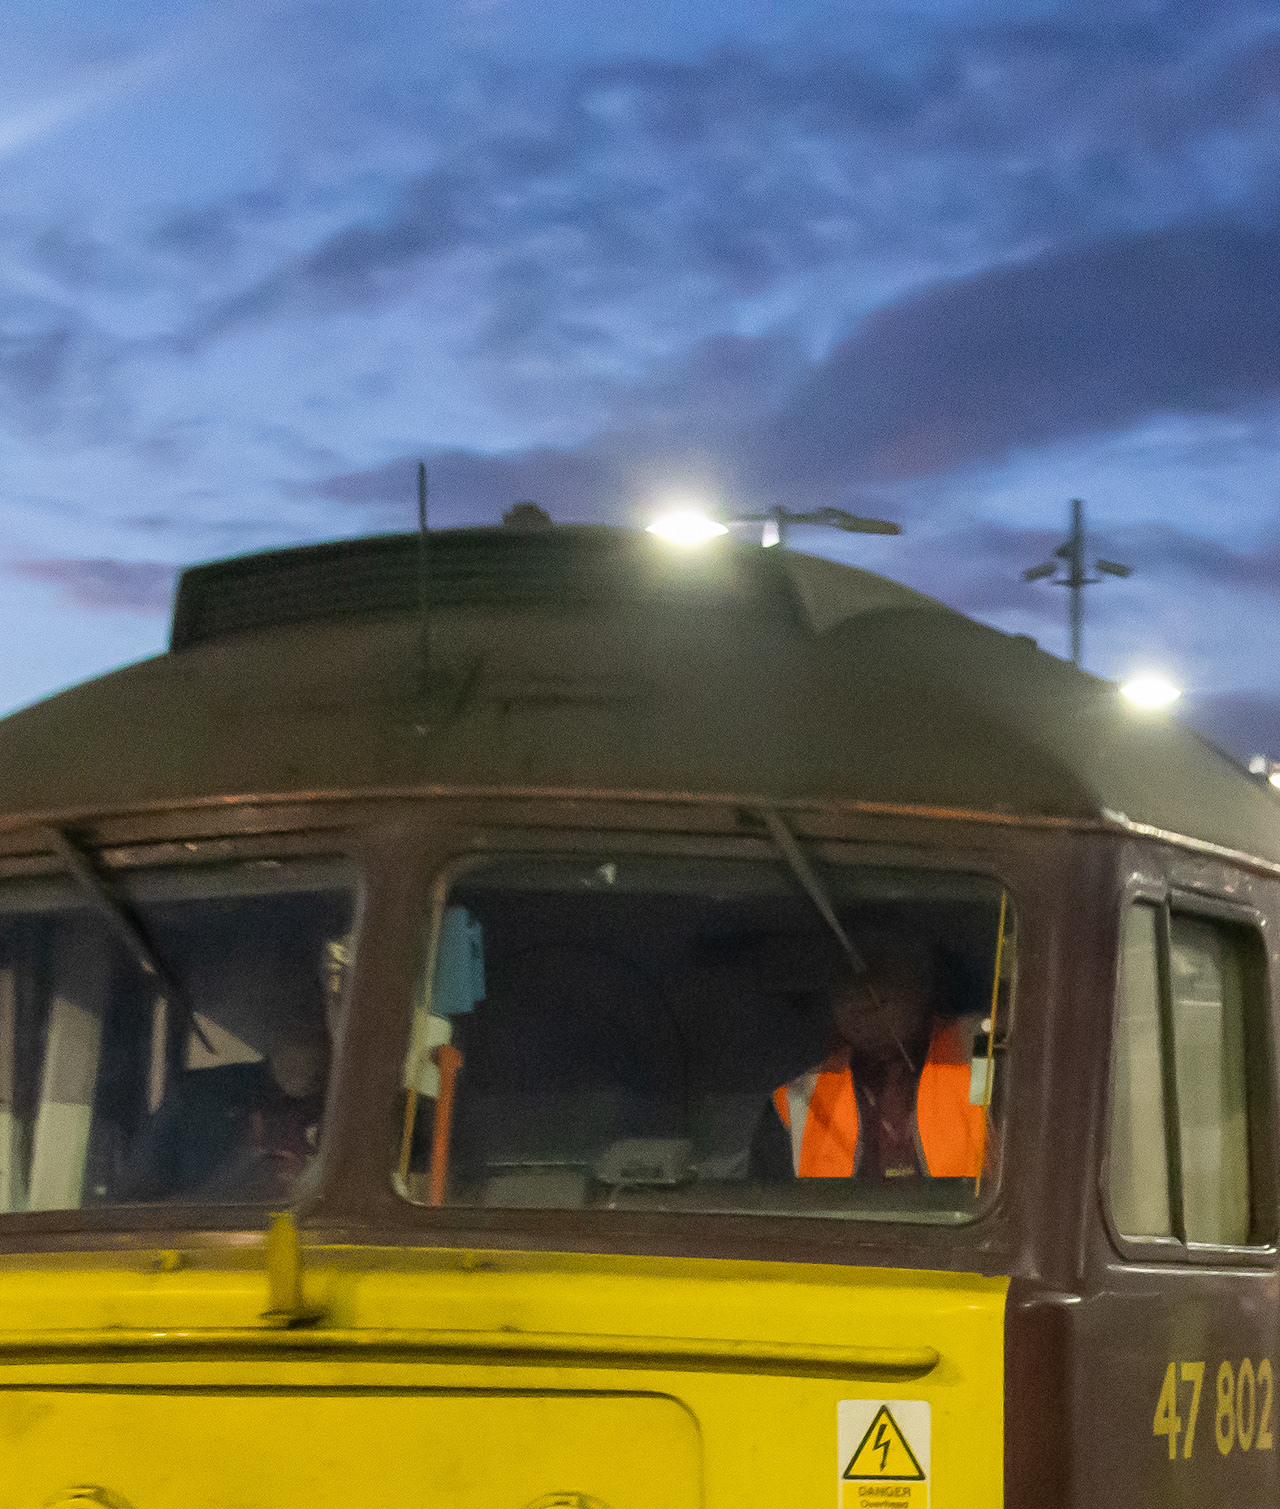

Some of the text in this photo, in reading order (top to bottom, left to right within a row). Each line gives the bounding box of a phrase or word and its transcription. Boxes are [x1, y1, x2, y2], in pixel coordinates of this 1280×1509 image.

[1152, 1357, 1273, 1460] 47 802
[858, 1486, 911, 1497] DANGER
